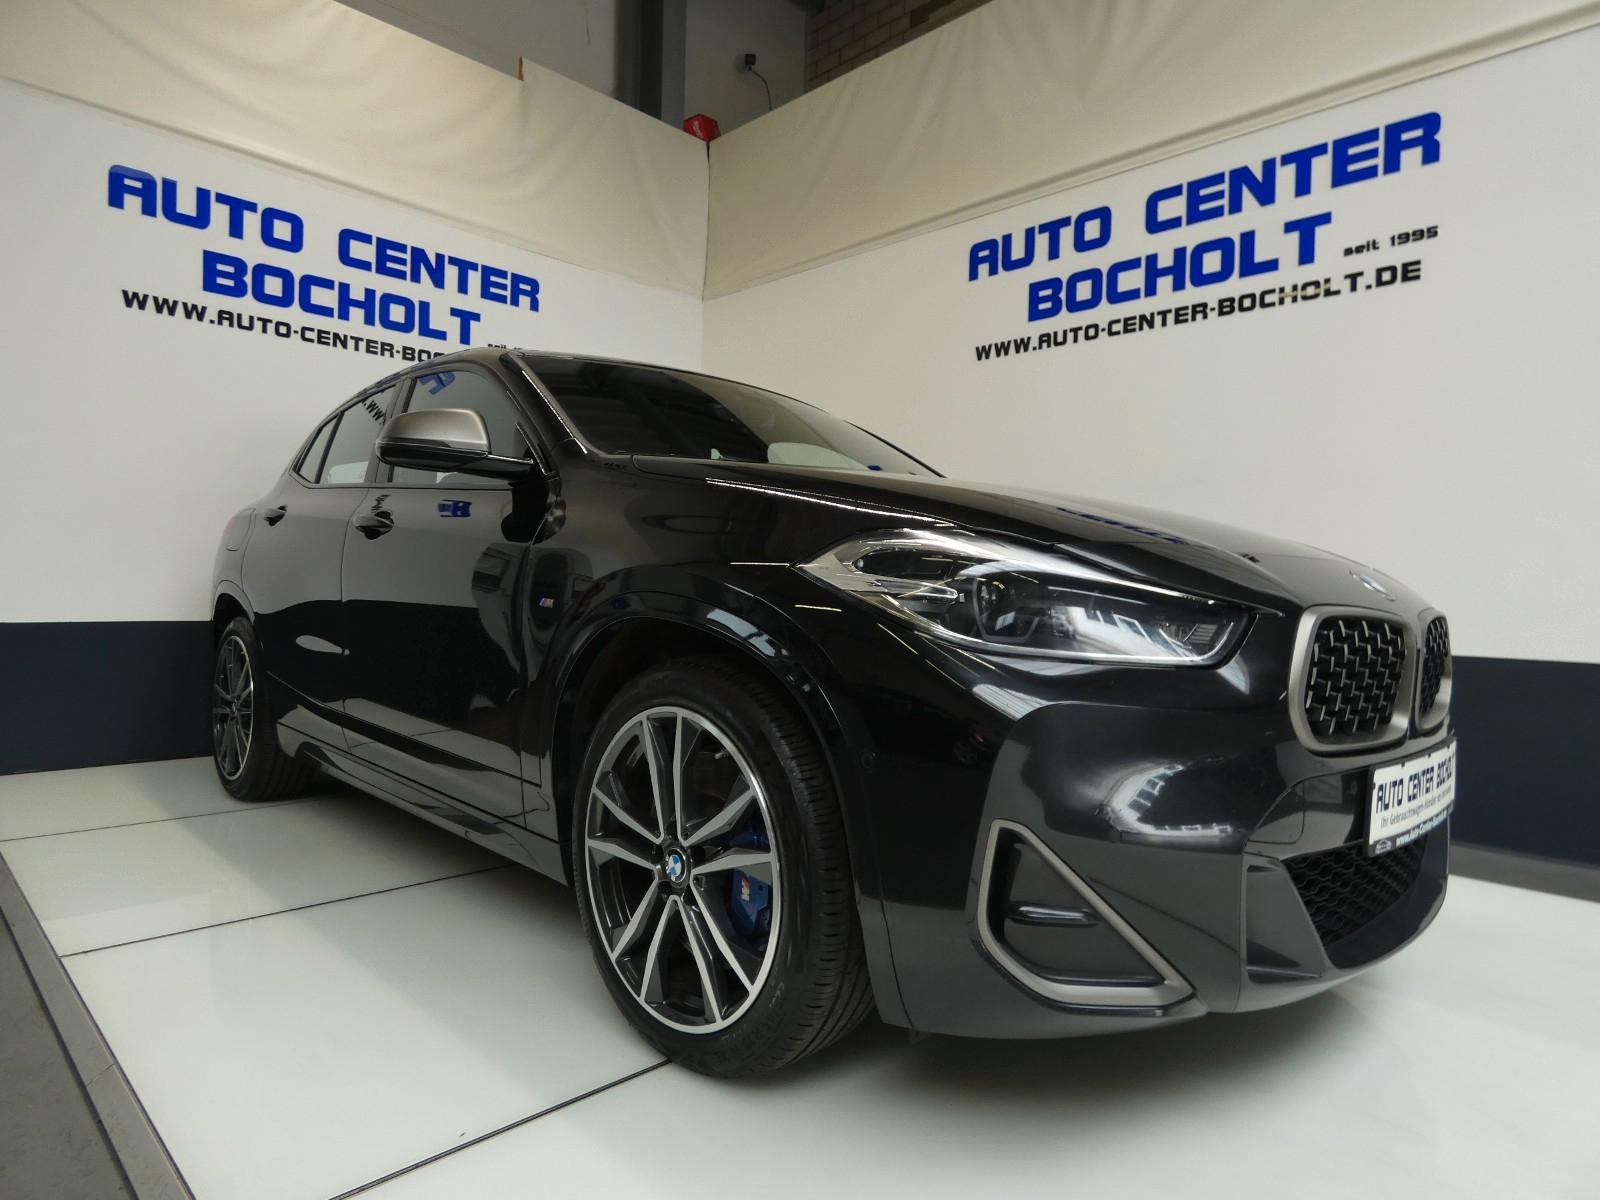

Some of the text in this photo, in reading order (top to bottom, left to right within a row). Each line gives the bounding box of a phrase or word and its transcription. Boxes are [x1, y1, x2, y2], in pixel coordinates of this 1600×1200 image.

[108, 164, 540, 313] AUTO CENTER
[968, 111, 1442, 281] AUTO CENTER
[1343, 225, 1439, 257] seit 1995
[202, 249, 481, 346] BOCHOLT
[975, 259, 1422, 362] WWW.AUTO-CENTER-BOCHOLT.DE
[1028, 211, 1333, 322] BOCHOLT
[1376, 778, 1404, 814] AUTO
[1407, 765, 1434, 802] CENTER
